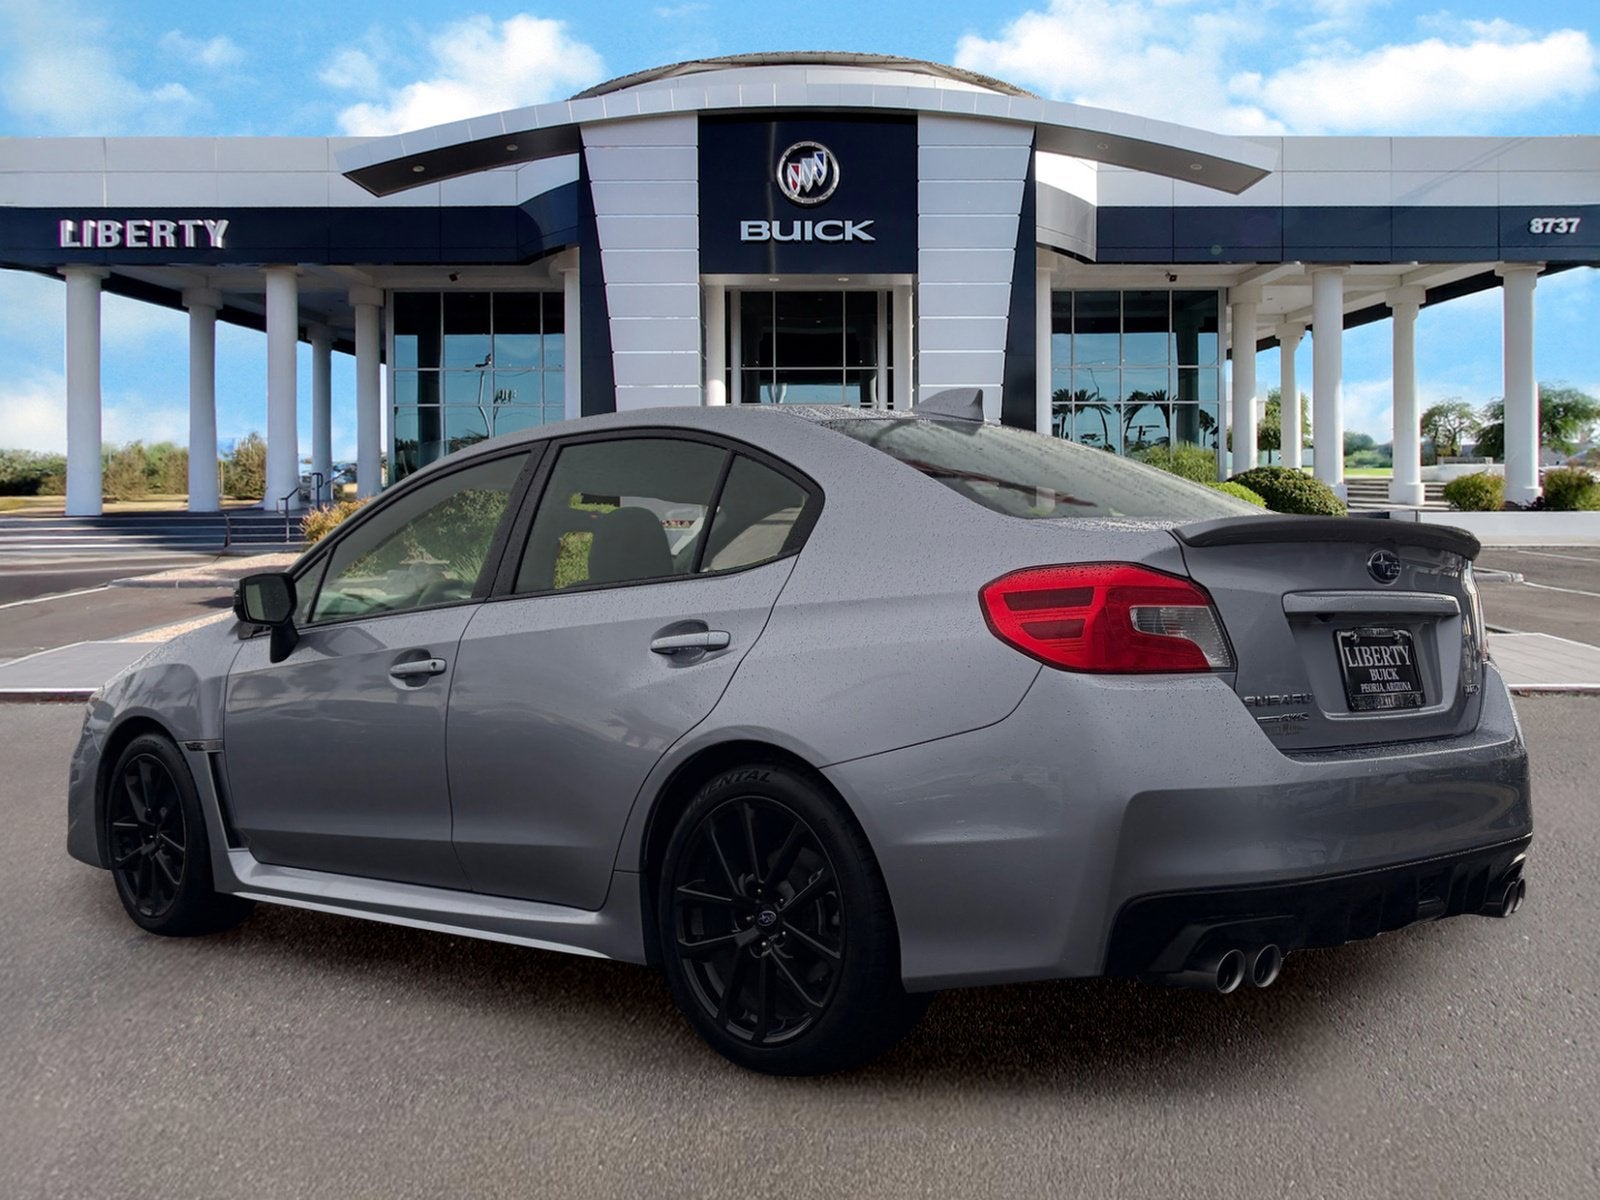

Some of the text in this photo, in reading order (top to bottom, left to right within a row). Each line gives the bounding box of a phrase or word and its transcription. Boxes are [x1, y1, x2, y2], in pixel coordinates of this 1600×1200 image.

[59, 218, 230, 249] LIBERTY
[740, 219, 876, 242] BUICK
[1529, 217, 1581, 234] 8737
[1343, 645, 1411, 667] LIBERTY
[1369, 668, 1399, 681] BUICK
